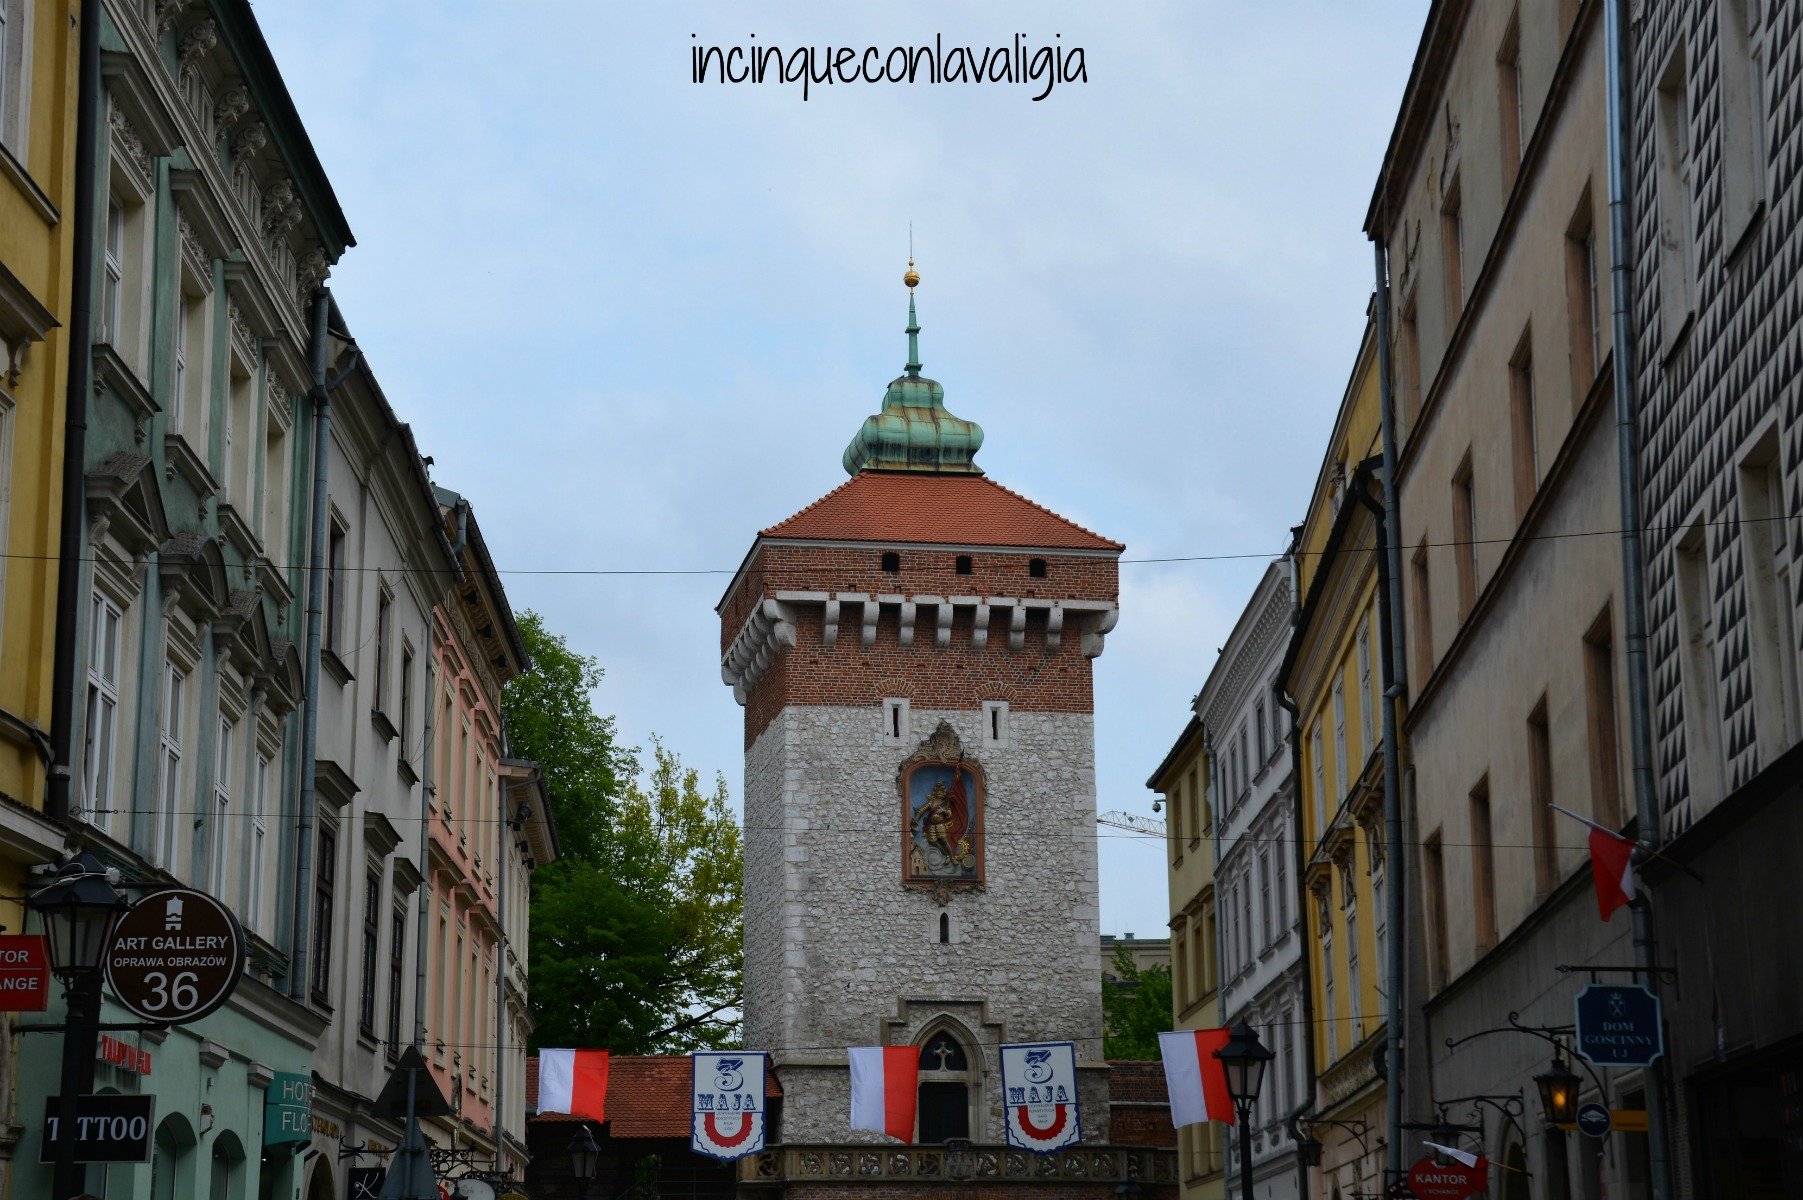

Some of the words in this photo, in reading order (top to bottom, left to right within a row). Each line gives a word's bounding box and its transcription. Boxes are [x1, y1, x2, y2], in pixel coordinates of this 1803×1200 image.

[114, 937, 148, 951] ART
[152, 936, 229, 950] GALLERY
[114, 957, 165, 968] OPRAWA
[167, 954, 227, 967] OBRAZÓW
[141, 971, 199, 1011] 36
[1602, 1021, 1635, 1032] DOM
[714, 1057, 744, 1092] 3
[1024, 1049, 1054, 1084] 3
[283, 1080, 312, 1103] HOT
[1008, 1085, 1069, 1104] MAJA
[697, 1093, 756, 1111] MAJA
[47, 1115, 147, 1141] TTTOO
[1414, 1173, 1467, 1185] KANTOR
